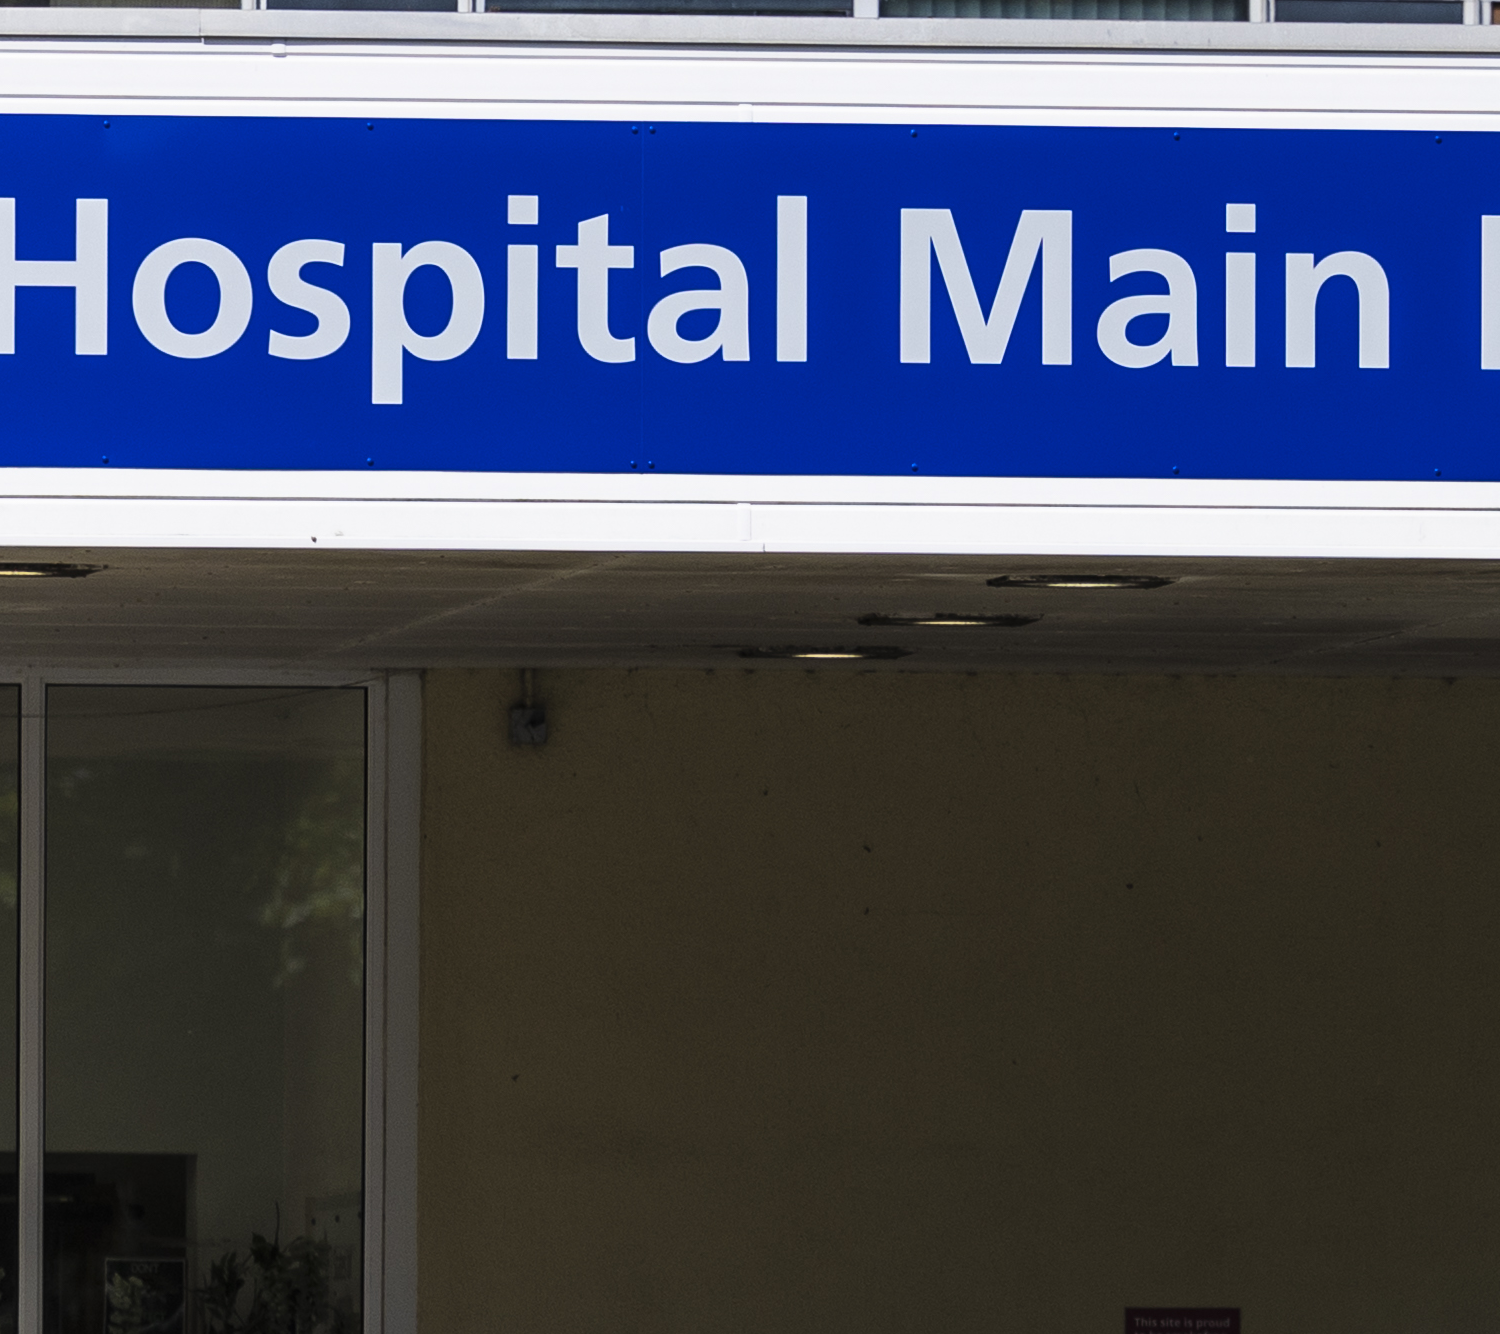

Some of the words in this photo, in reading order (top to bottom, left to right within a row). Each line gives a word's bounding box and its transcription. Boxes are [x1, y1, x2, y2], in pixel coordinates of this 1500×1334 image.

[901, 204, 1390, 369] Main
[1134, 1317, 1158, 1328] This
[1159, 1317, 1181, 1328] site
[1183, 1317, 1193, 1328] is
[1195, 1317, 1231, 1331] proud
